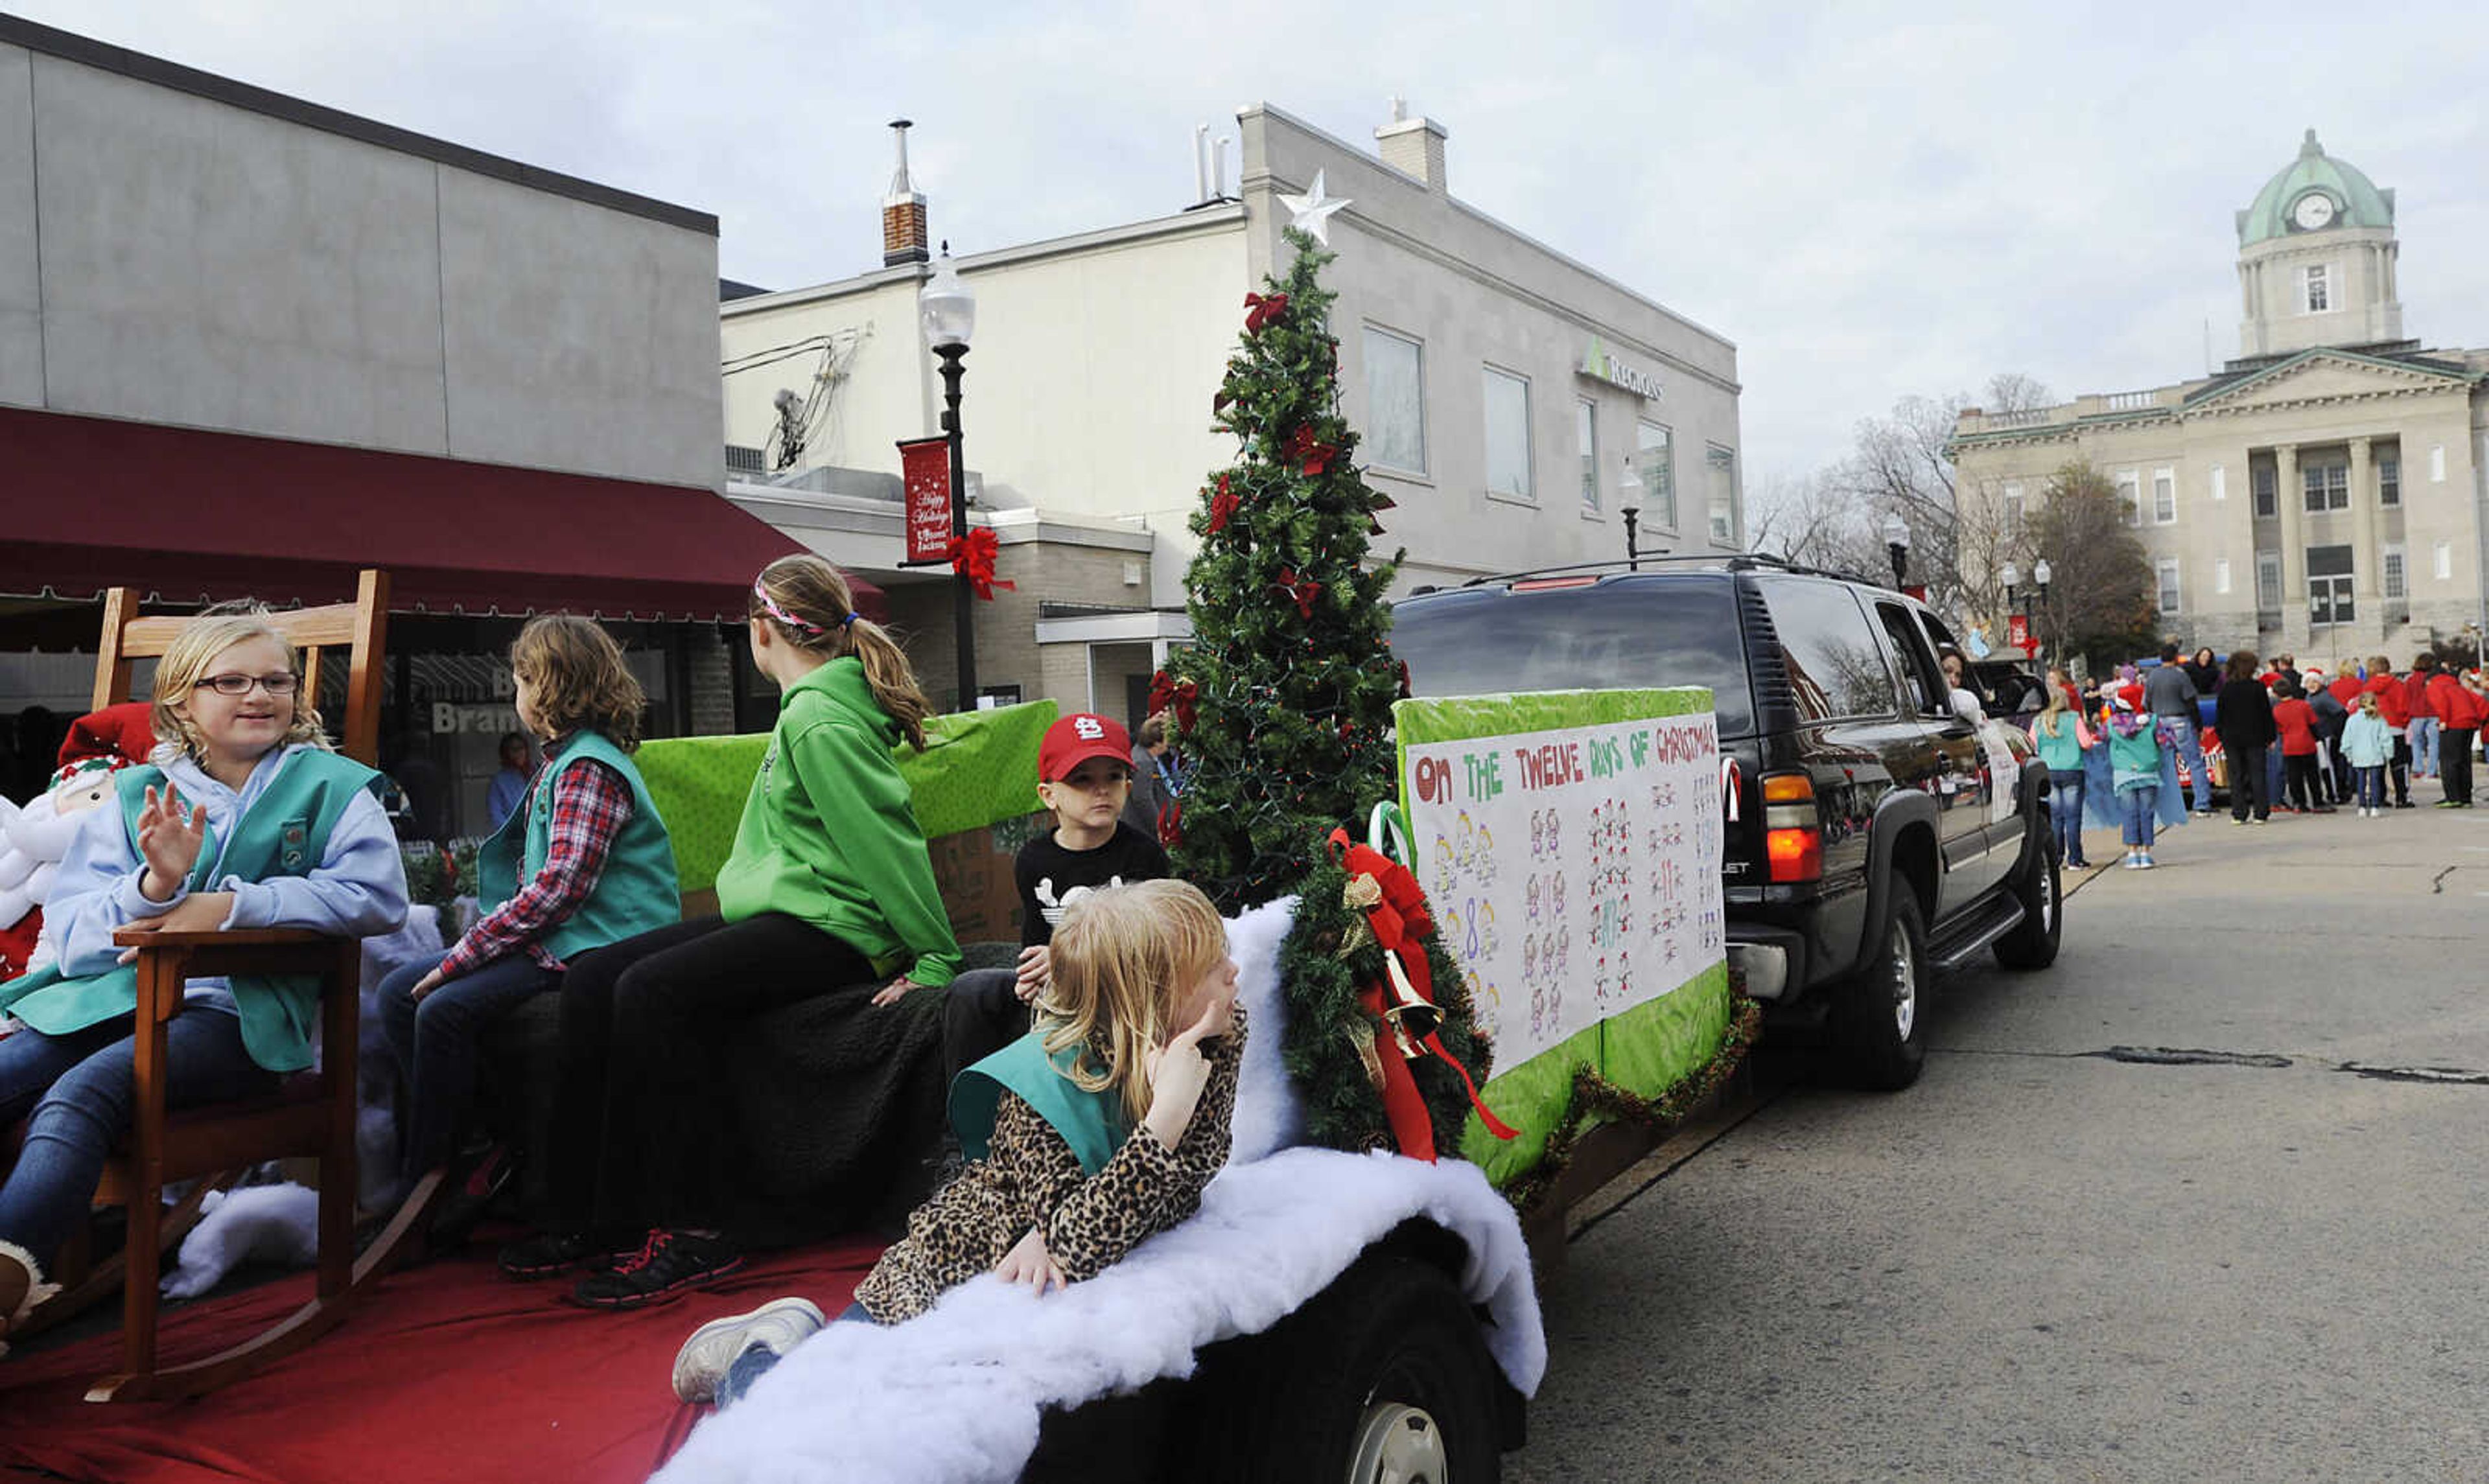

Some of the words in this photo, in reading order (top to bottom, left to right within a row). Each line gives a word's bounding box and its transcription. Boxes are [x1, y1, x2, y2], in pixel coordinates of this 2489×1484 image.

[433, 702, 519, 734] Bran
[1464, 750, 1503, 803] THE
[1515, 743, 1584, 791] TWELVE
[1589, 736, 1623, 779] DAYS
[1630, 730, 1649, 769] OF
[1657, 721, 1715, 765] CHRISTMAS
[1467, 897, 1478, 959] 8
